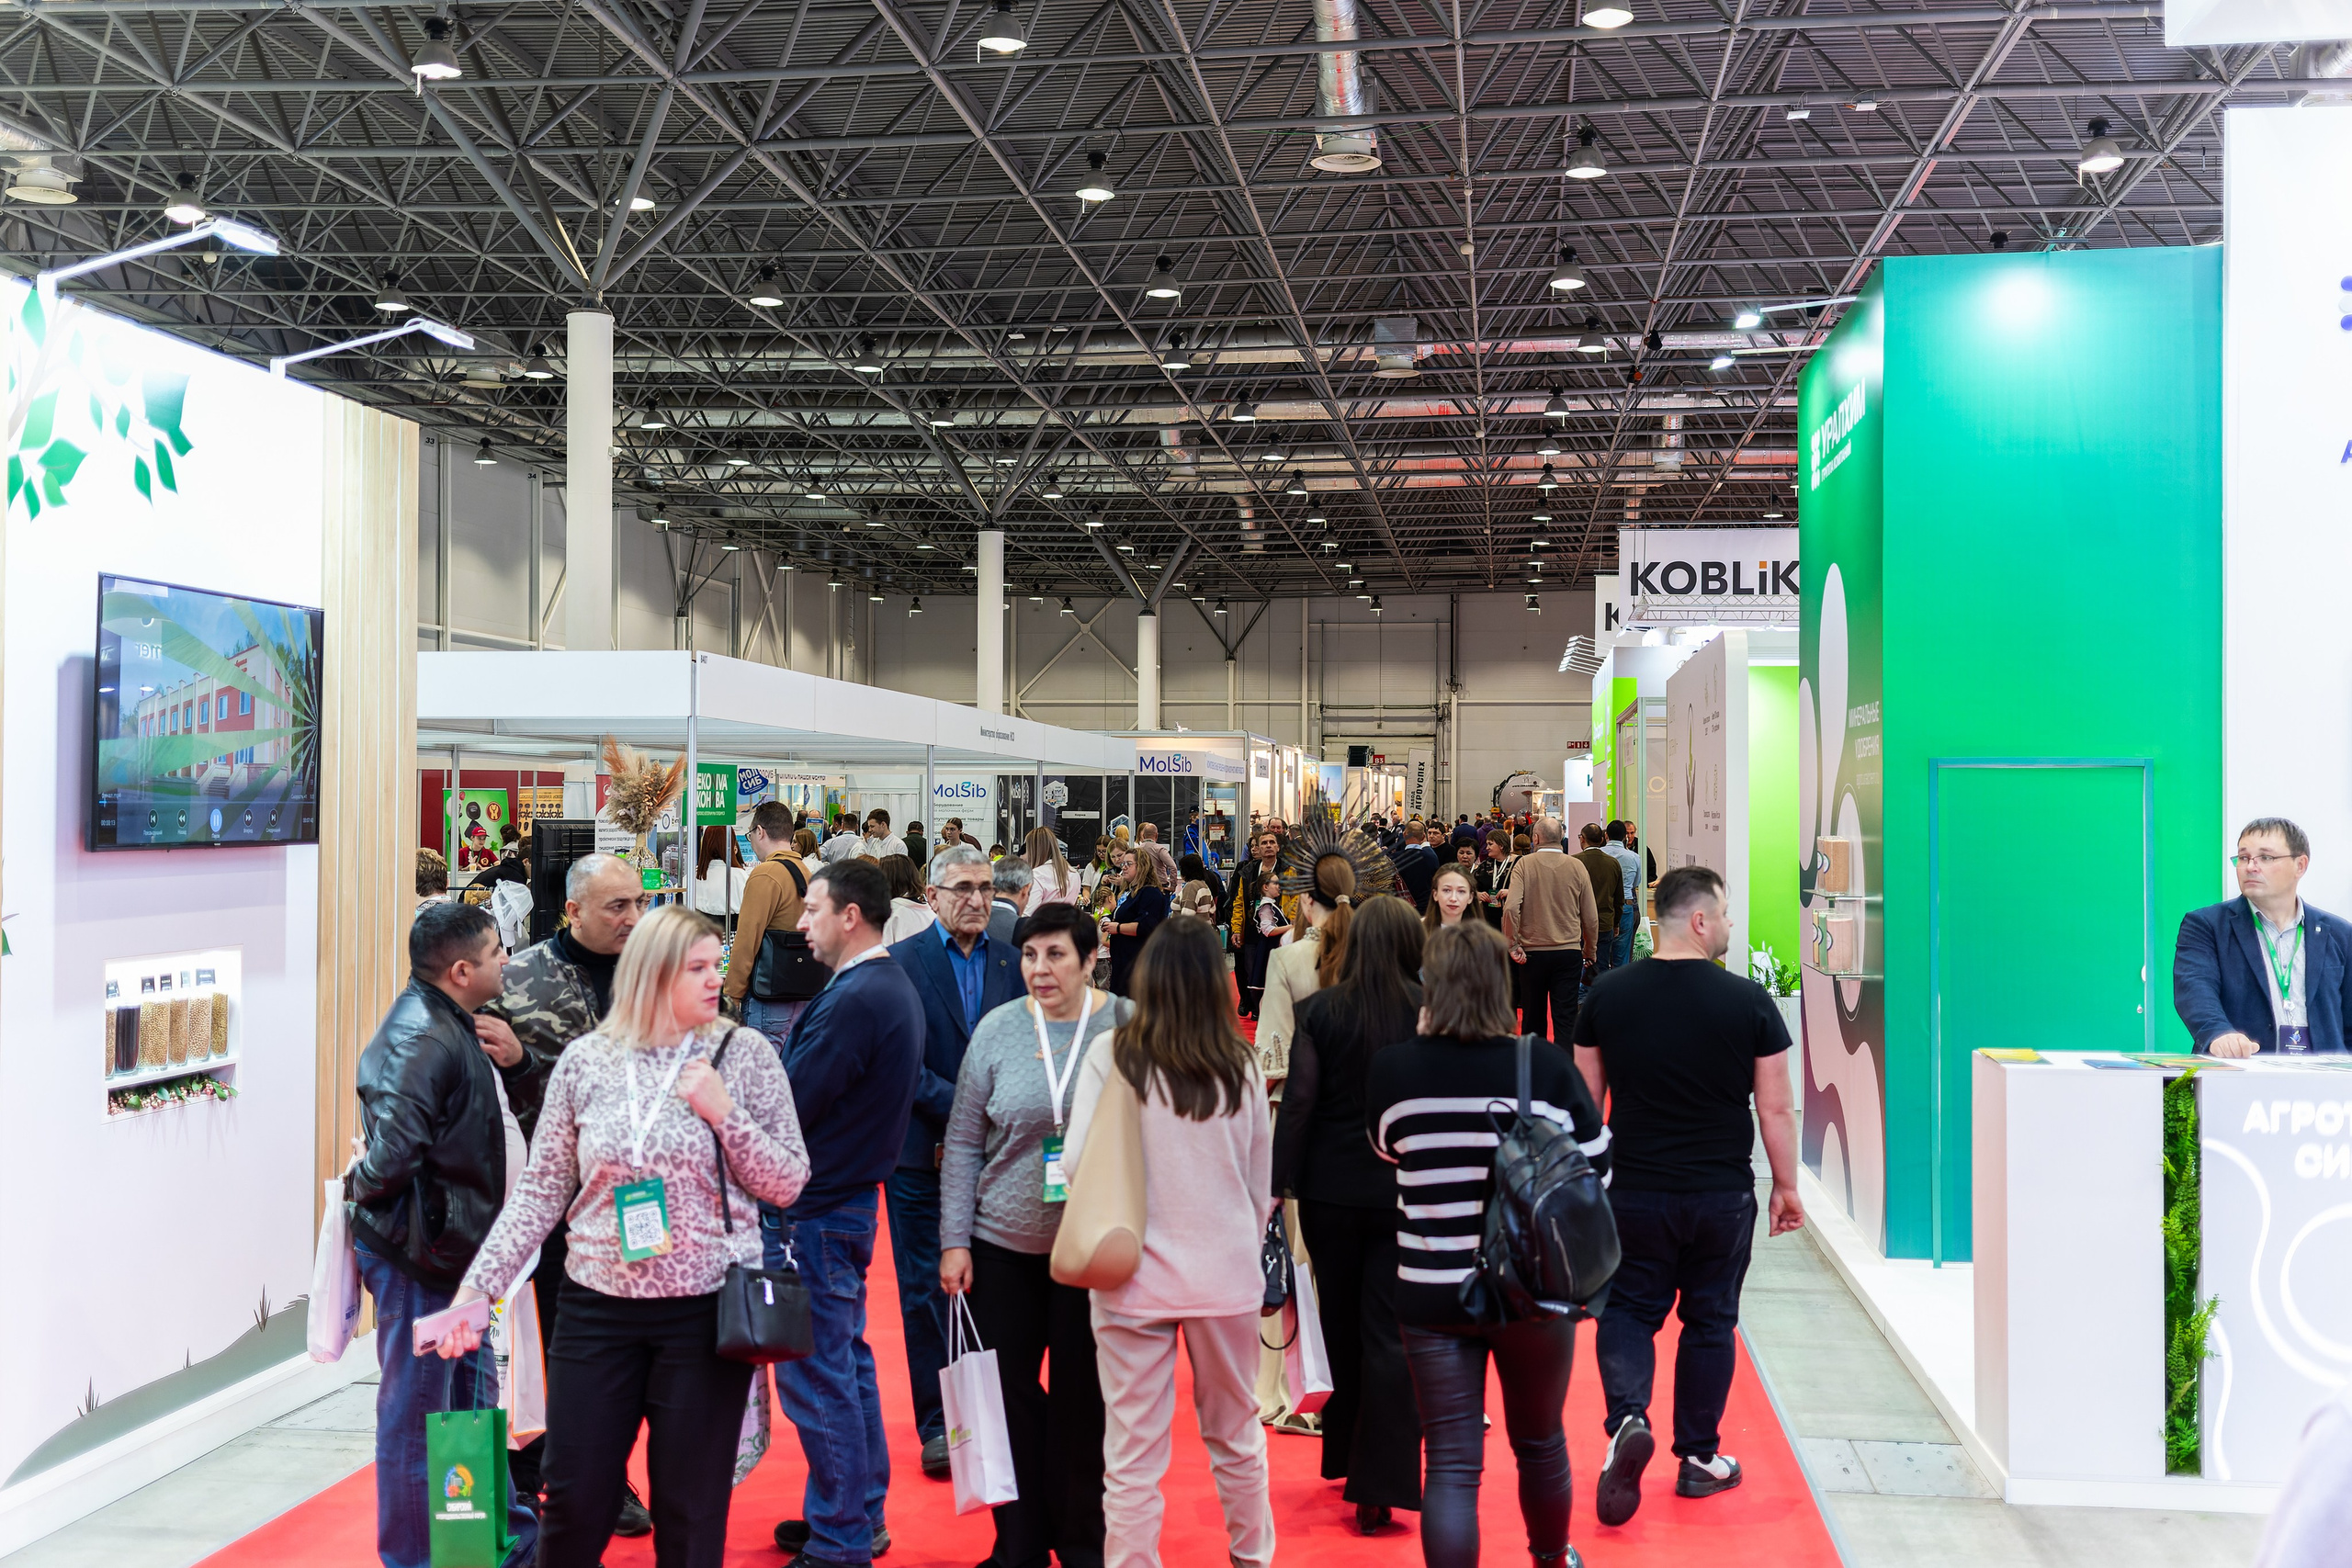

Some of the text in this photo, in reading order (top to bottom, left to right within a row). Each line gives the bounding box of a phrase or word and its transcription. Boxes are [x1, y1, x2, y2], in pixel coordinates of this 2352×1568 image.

[1630, 560, 1800, 596] KOBLiK
[1848, 701, 1880, 728] МИНЕРАЛЬНЫЕ
[1855, 735, 1880, 761] УДОБРЕНИЯ
[1139, 753, 1193, 773] MolSib
[742, 775, 763, 790] СИБ
[1415, 761, 1426, 810] АГРОУСПЕХ
